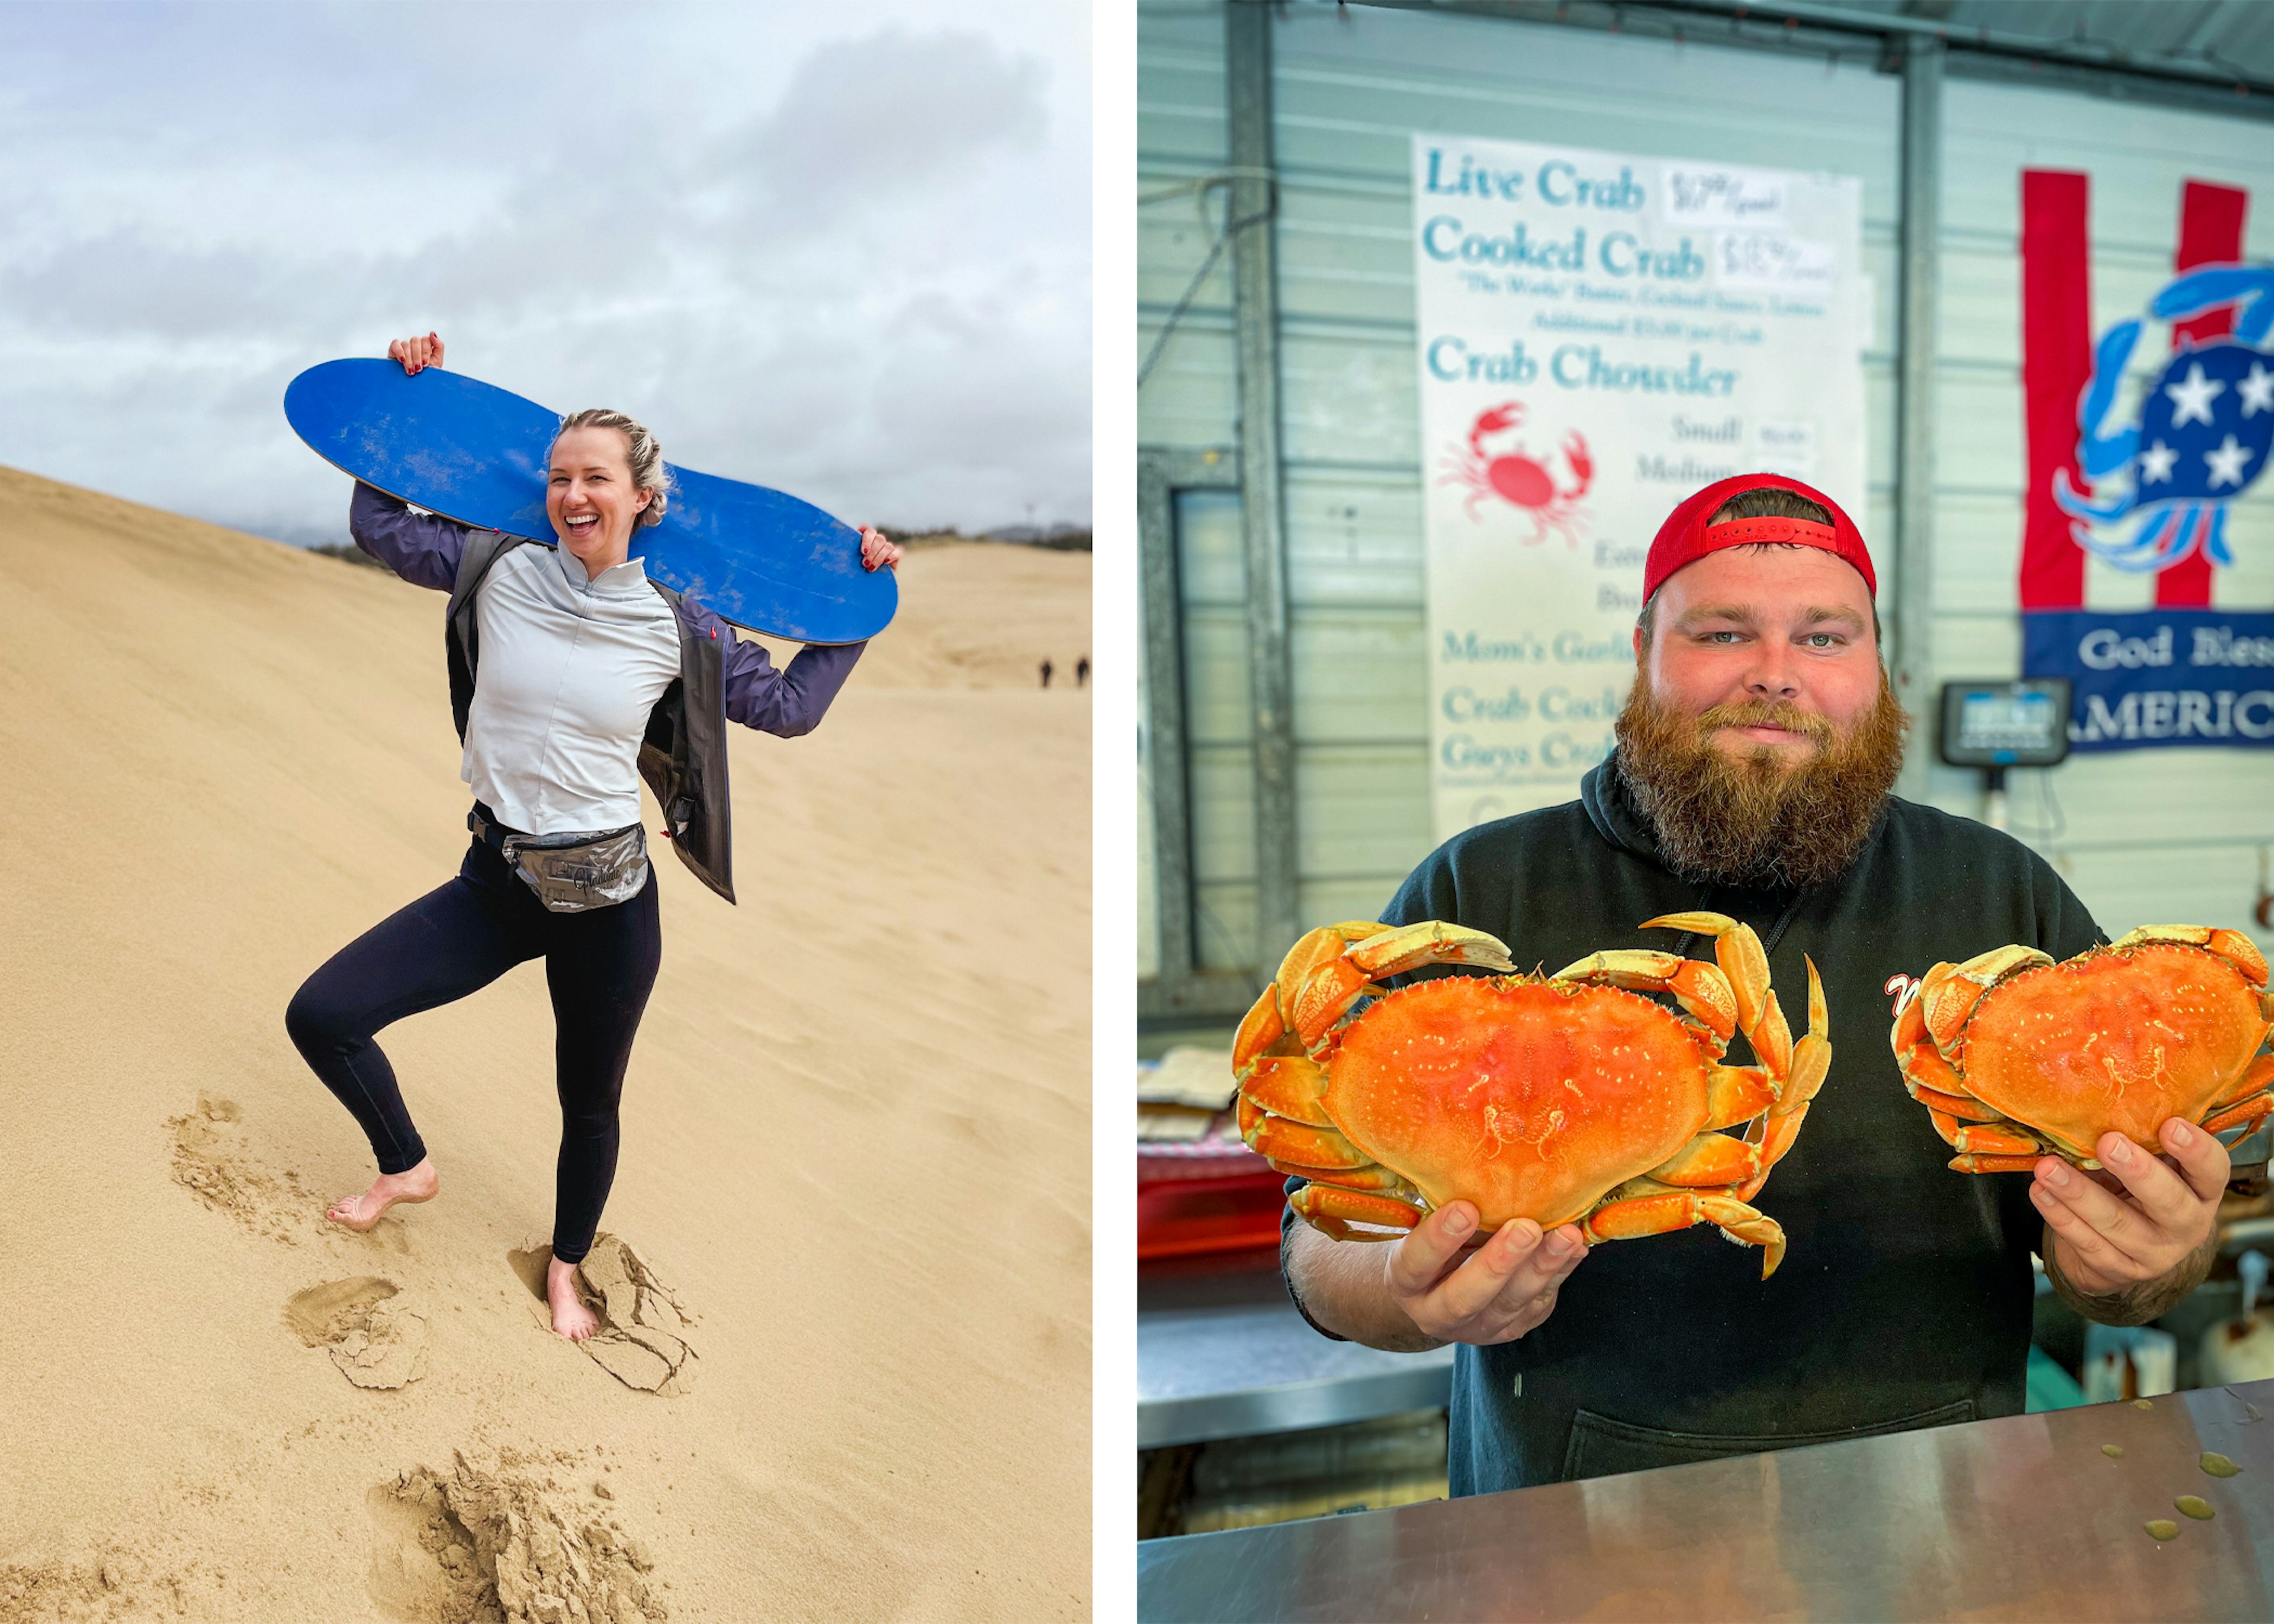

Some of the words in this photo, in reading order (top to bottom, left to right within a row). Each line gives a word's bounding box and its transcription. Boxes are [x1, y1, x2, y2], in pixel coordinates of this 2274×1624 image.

[1425, 148, 1525, 201] Live
[1536, 159, 1646, 213] Crab
[1422, 214, 1586, 272] Cooked
[1599, 230, 1704, 281] Crab
[1426, 335, 1538, 384] Crab
[1551, 342, 1739, 397] Chowder
[1671, 413, 1743, 444] Small
[1441, 628, 1546, 664] Mom's
[1552, 628, 1638, 665] Garli
[2079, 625, 2175, 670] God
[1441, 685, 1531, 724] Crab
[1537, 685, 1626, 724] Cock
[2066, 690, 2273, 742] MERIC
[1441, 732, 1531, 779] Guys
